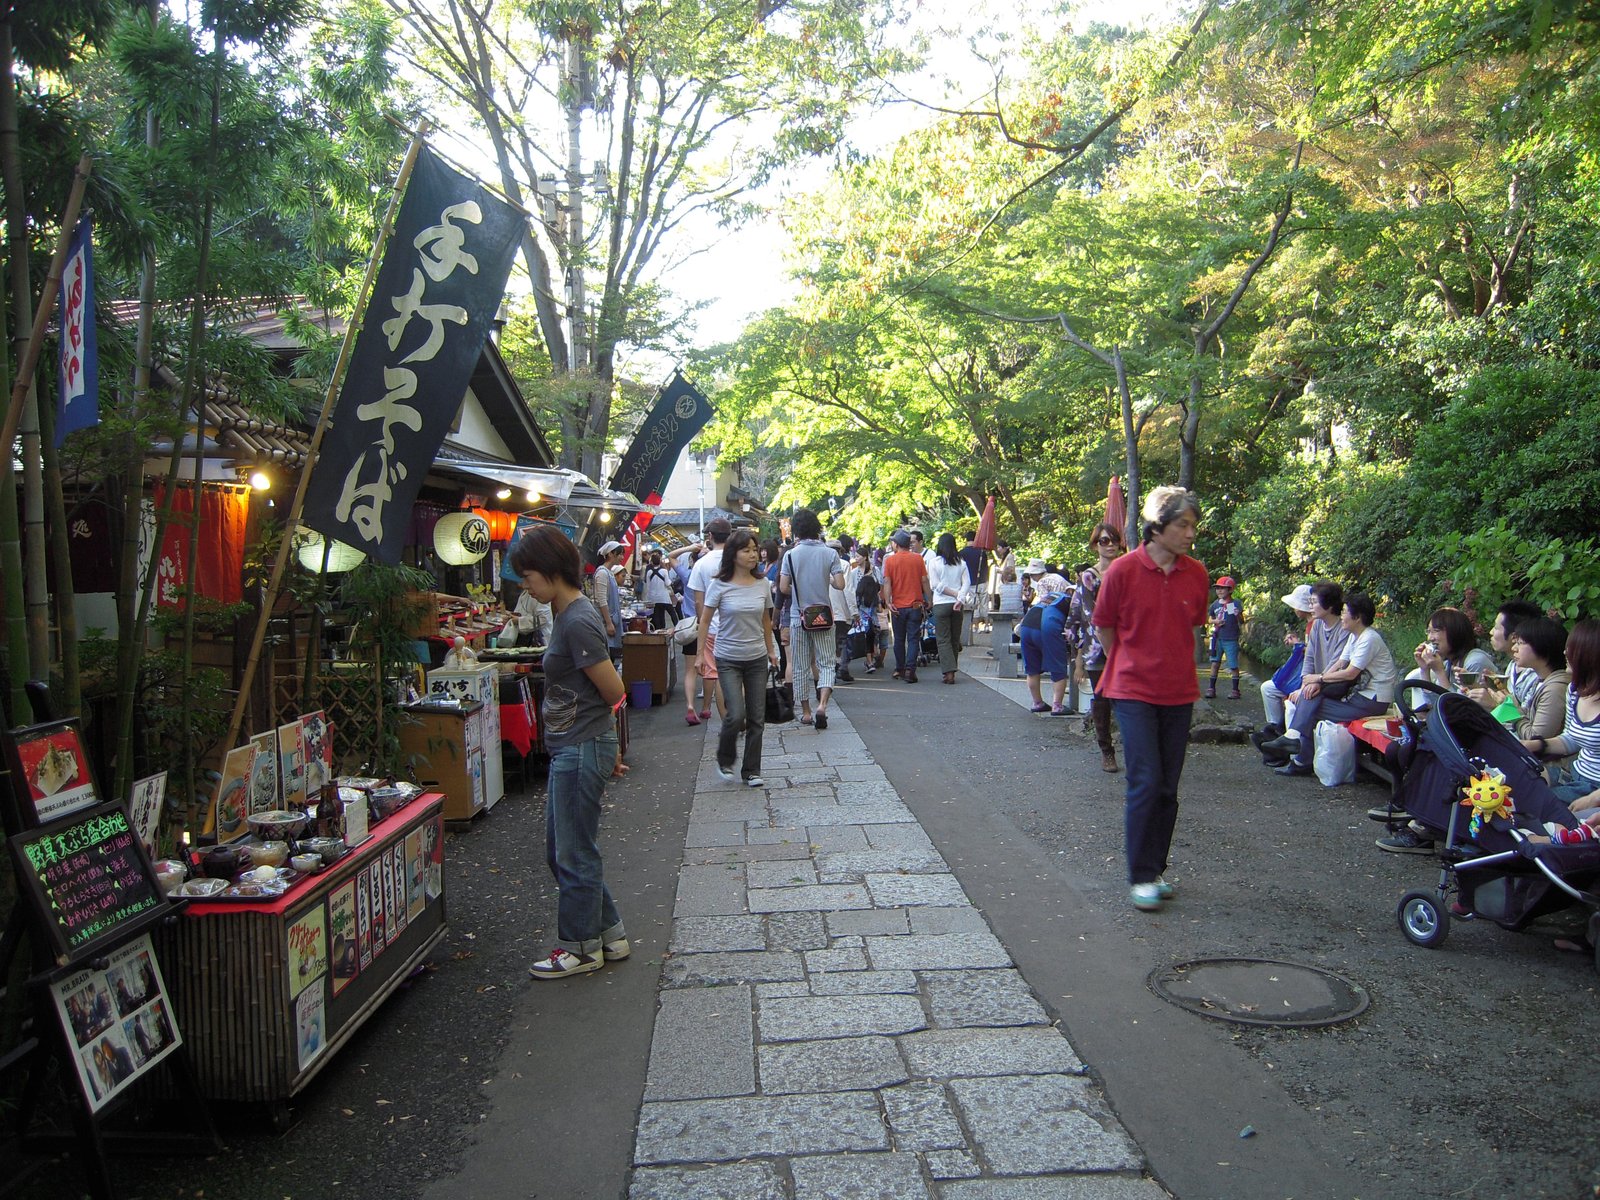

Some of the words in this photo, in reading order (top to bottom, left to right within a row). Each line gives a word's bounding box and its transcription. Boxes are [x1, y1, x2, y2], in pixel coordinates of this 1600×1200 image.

[335, 200, 483, 545] 手打そば
[431, 679, 469, 693] あいす
[24, 811, 129, 871] 野草天ぷら盛合わせ
